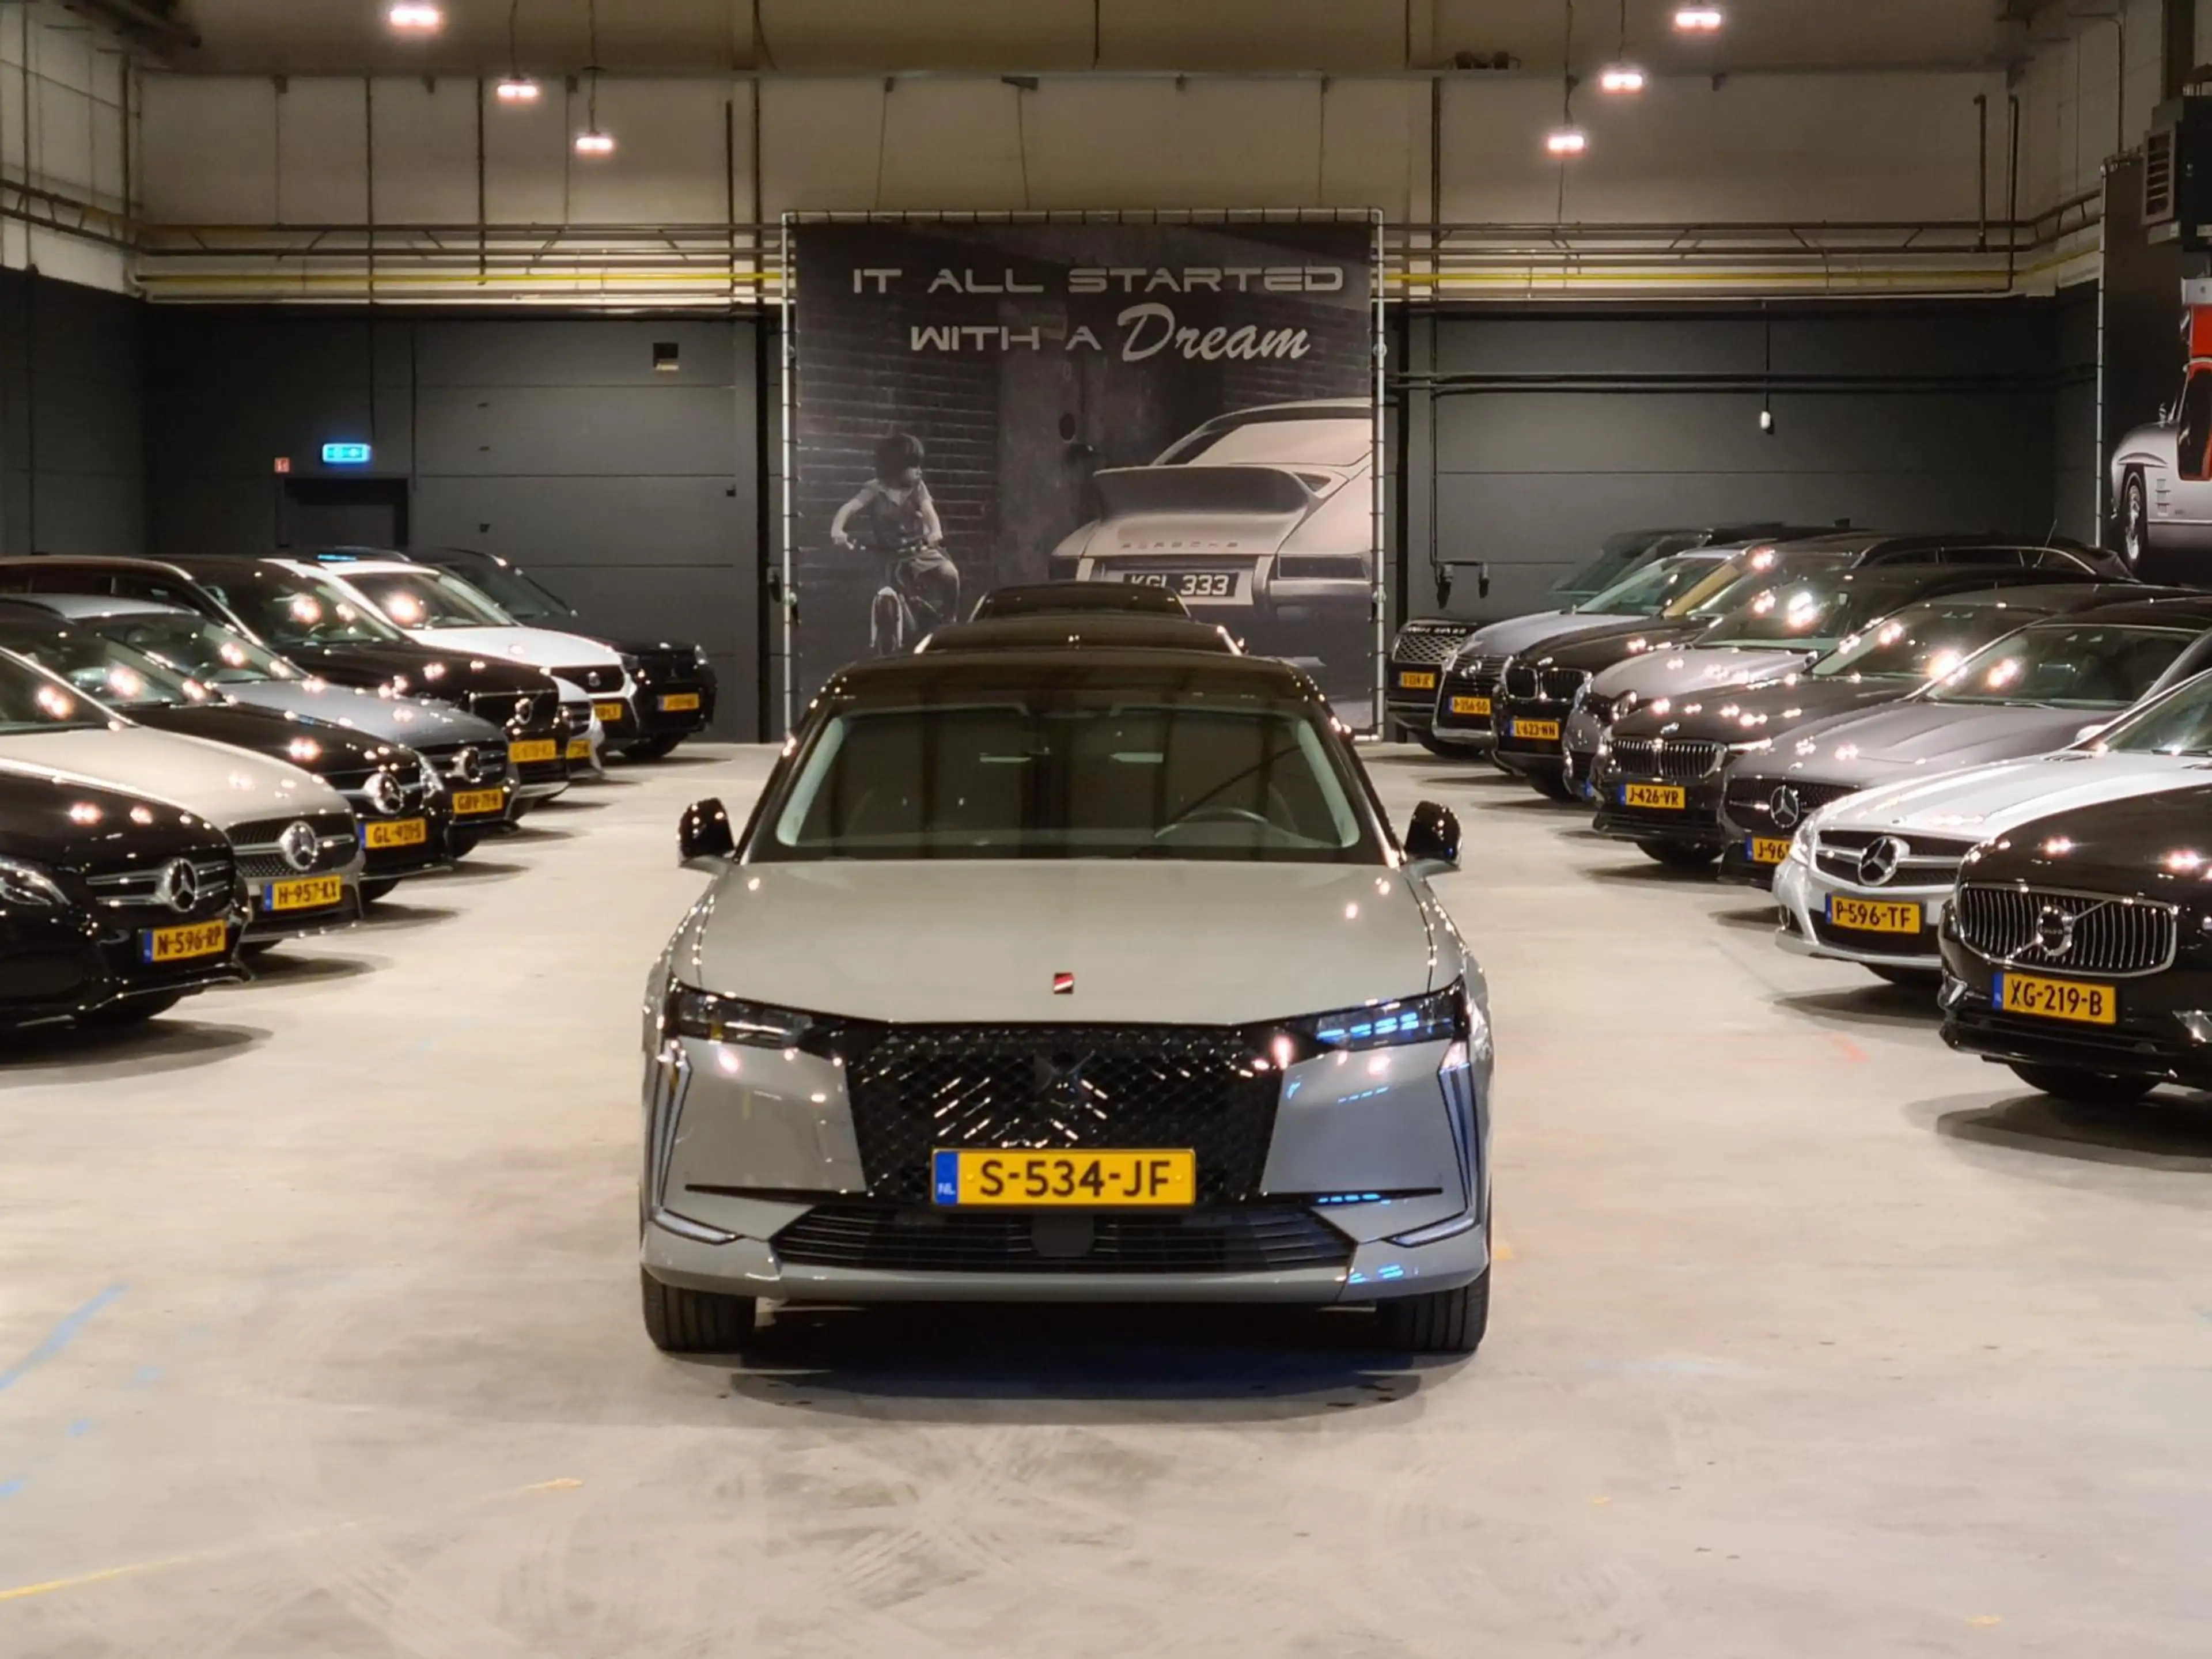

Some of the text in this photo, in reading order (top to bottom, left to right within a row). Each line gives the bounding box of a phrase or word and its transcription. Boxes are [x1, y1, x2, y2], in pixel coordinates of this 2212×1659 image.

[854, 267, 1343, 293] IT ALL STARTED
[911, 302, 1311, 362] WITH A Dream
[1180, 575, 1229, 596] 333
[1628, 790, 1679, 805] J-426-VR
[1758, 839, 1790, 858] J-96
[1836, 903, 1911, 930] P-596-TF
[2011, 980, 2103, 1017] XG-219-B
[938, 1160, 1171, 1197] NL S-534-JF
